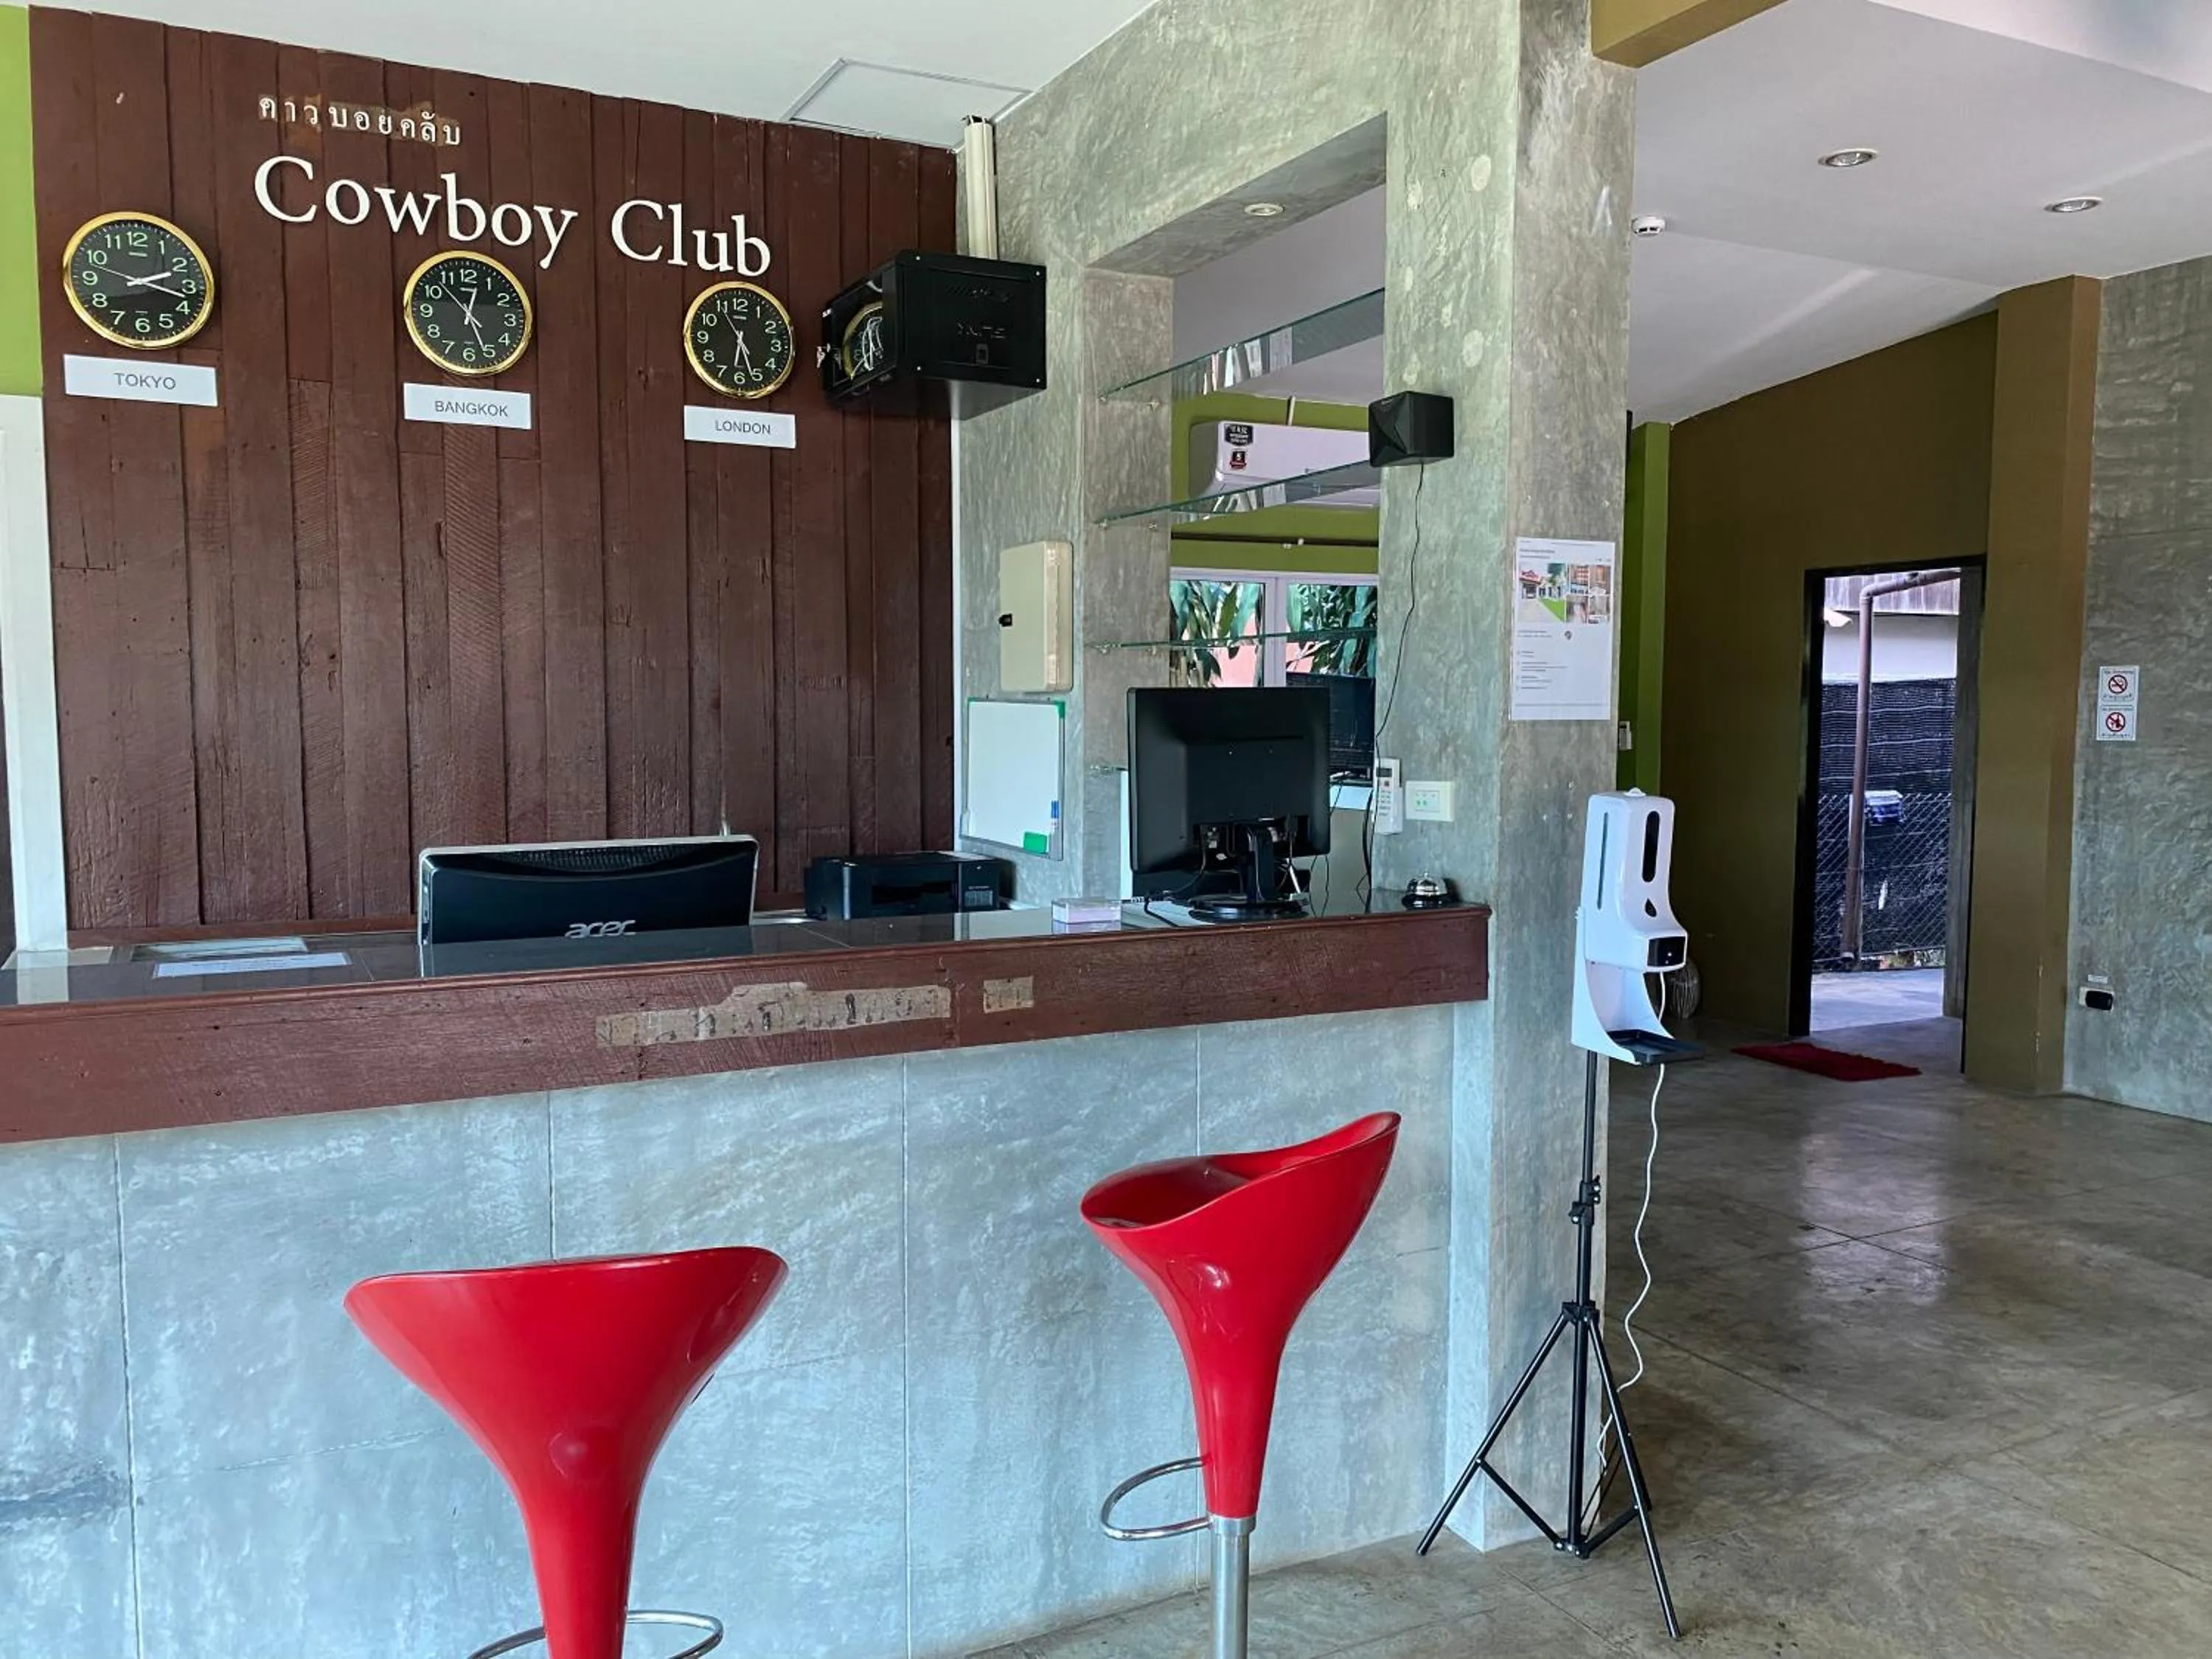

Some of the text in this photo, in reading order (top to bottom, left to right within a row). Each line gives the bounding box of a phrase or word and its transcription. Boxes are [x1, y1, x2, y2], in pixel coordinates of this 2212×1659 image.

[254, 155, 771, 276] Cowboy Club
[104, 234, 121, 250] 11
[126, 232, 147, 247] 12
[158, 240, 165, 255] 1
[86, 249, 107, 265] 10
[172, 257, 188, 272] 2
[82, 271, 98, 285] 9
[440, 271, 453, 285] 11
[459, 268, 478, 284] 12
[486, 276, 492, 291] 1
[181, 279, 197, 294] 3
[425, 285, 442, 299] 10
[92, 293, 108, 307] 8
[175, 300, 190, 315] 4
[496, 293, 509, 307] 2
[716, 299, 728, 313] 11
[732, 297, 748, 312] 12
[111, 310, 126, 325] 7
[420, 303, 433, 318] 9
[756, 305, 760, 319] 1
[135, 318, 150, 333] 6
[159, 313, 174, 328] 5
[504, 313, 516, 327] 3
[701, 313, 717, 327] 10
[765, 321, 776, 333] 2
[427, 324, 440, 338] 8
[697, 330, 709, 344] 9
[442, 339, 455, 355] 7
[498, 333, 510, 347] 4
[771, 339, 782, 352] 3
[462, 347, 476, 362] 6
[483, 344, 495, 358] 5
[703, 349, 714, 363] 8
[765, 357, 776, 370] 4
[716, 365, 728, 378] 7
[734, 371, 745, 384] 6
[751, 368, 763, 381] 5
[114, 372, 176, 390] TOKYO
[434, 400, 508, 417] BANGKOK
[715, 420, 771, 435] LONDON
[564, 919, 636, 939] acer
